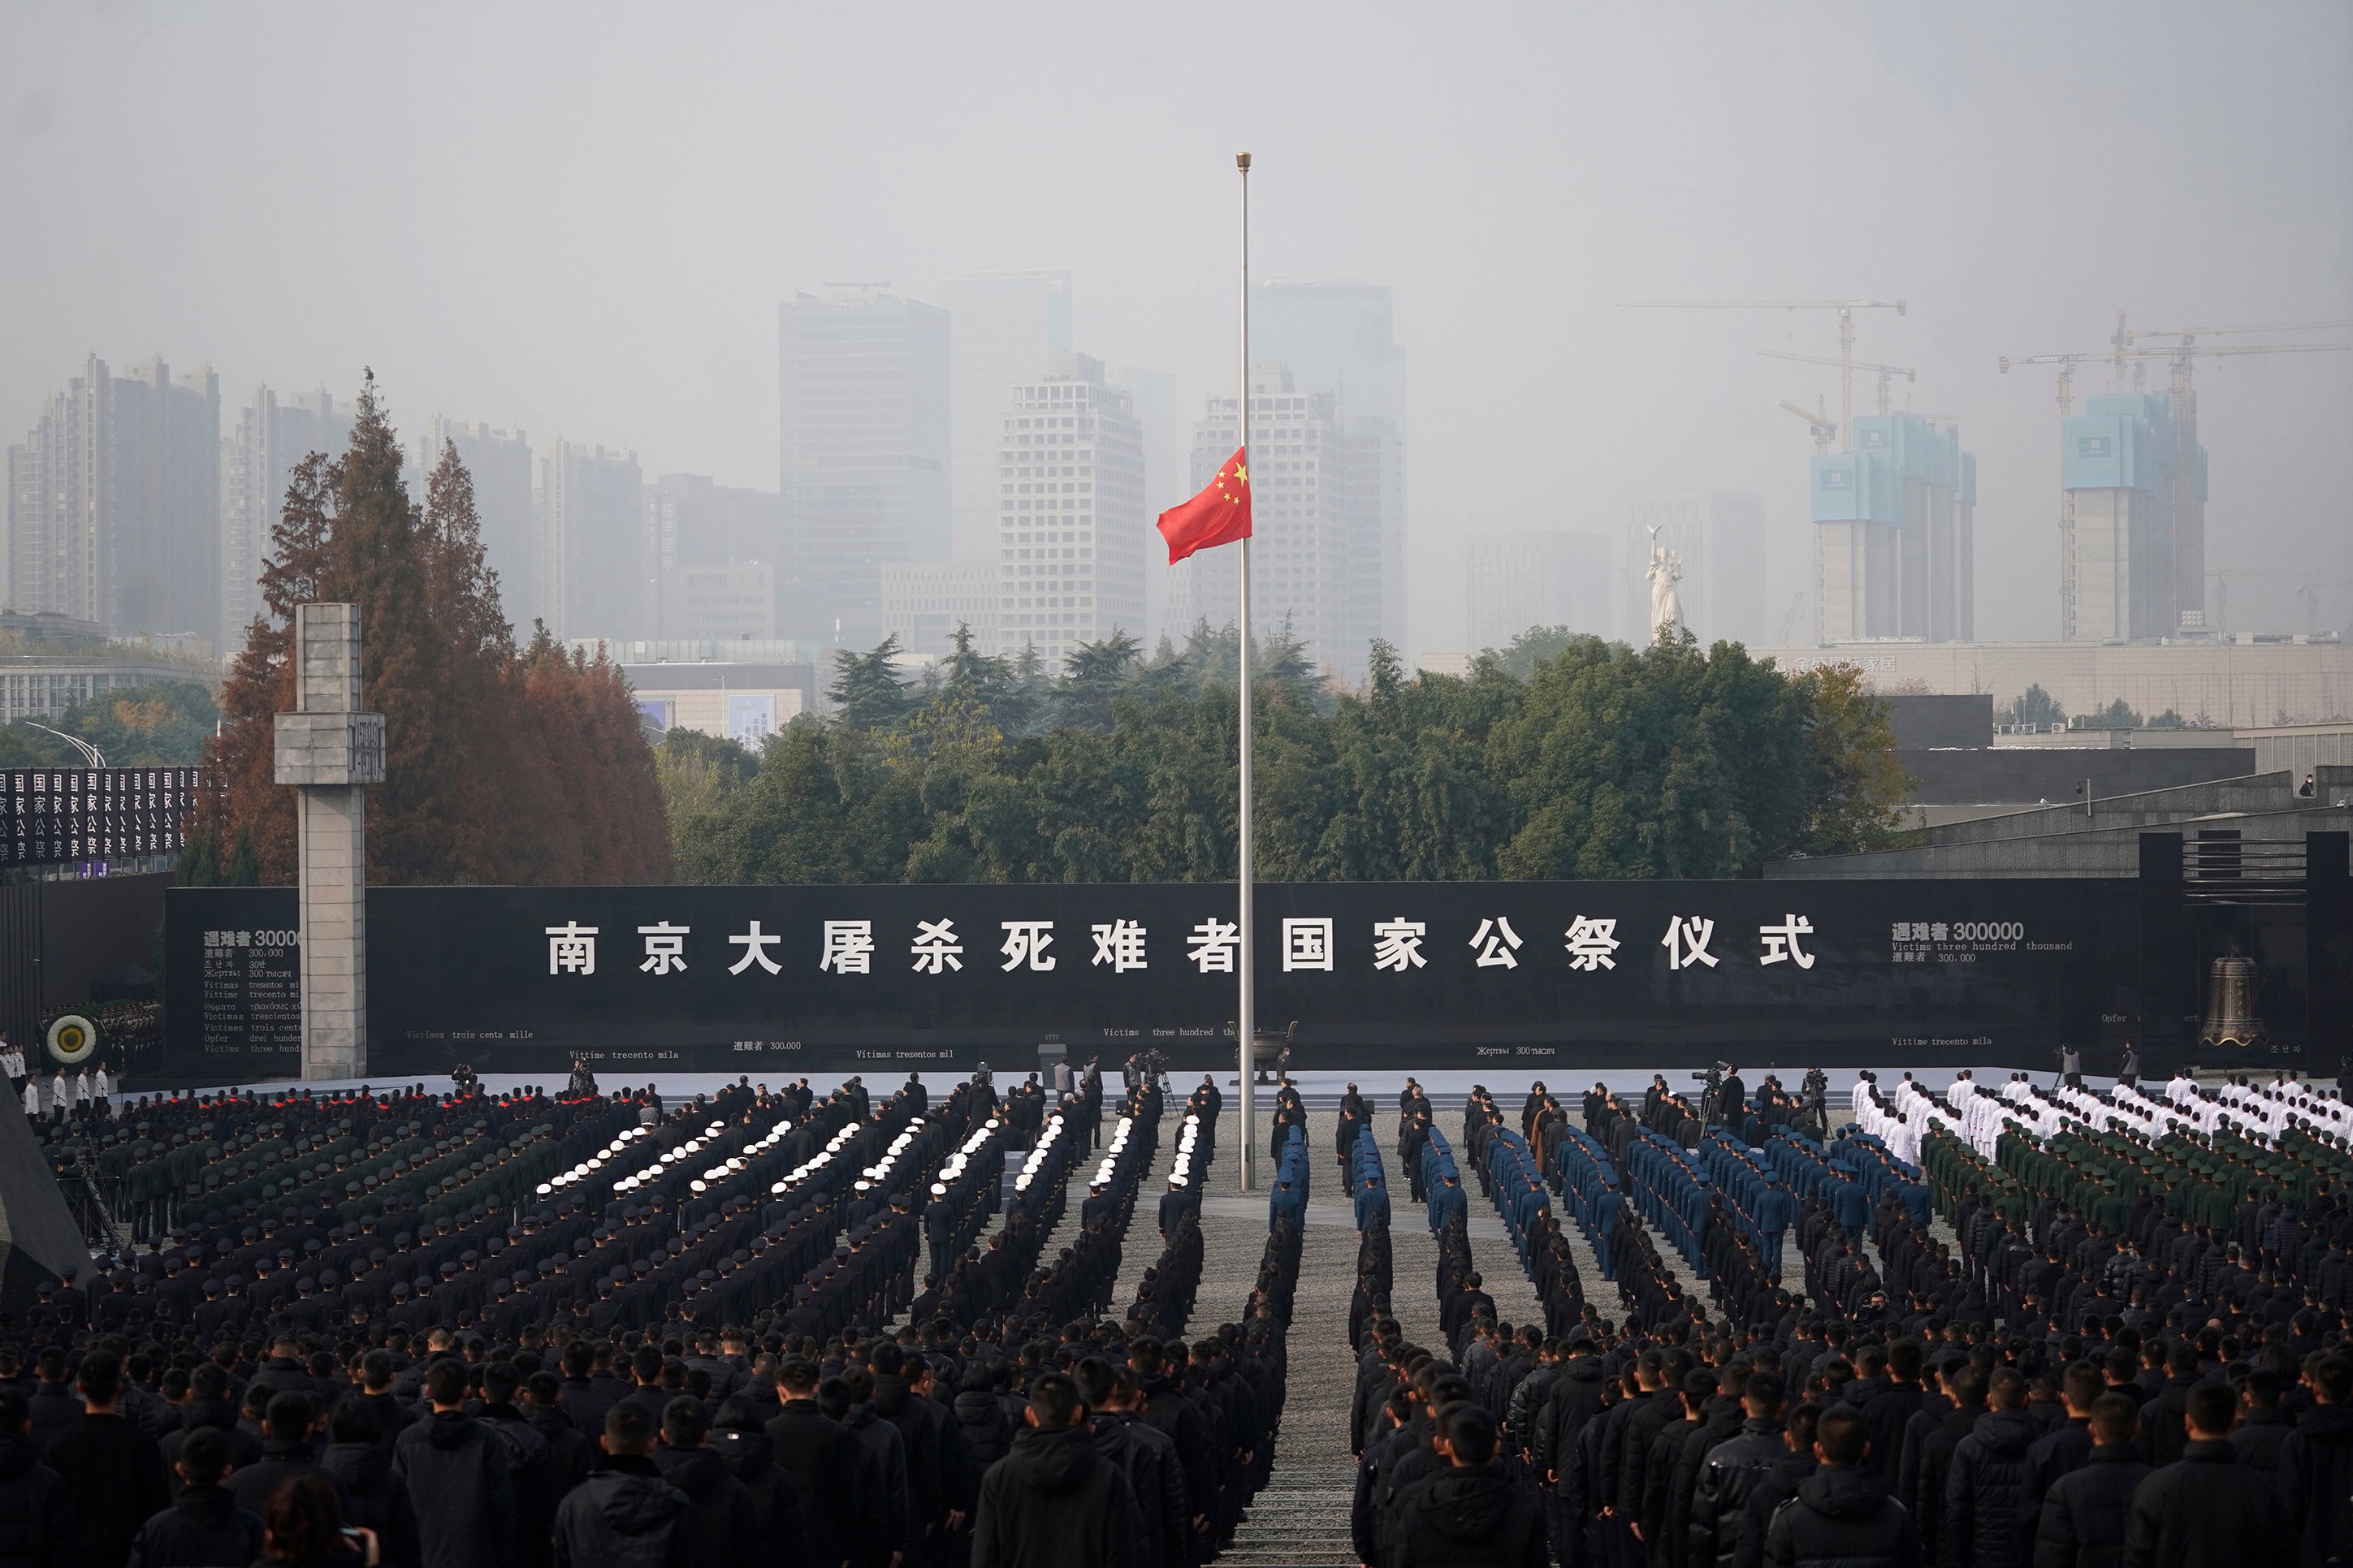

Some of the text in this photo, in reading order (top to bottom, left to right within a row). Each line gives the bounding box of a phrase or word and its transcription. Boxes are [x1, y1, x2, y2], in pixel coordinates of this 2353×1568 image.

[33, 774, 46, 857] 国家公祭
[87, 773, 97, 854] 国家公祭
[1953, 922, 2024, 941] 300000
[255, 930, 301, 947] 3000
[1892, 940, 2073, 952] Victims three hundred thousand
[249, 991, 287, 999] trecento
[2101, 1013, 2127, 1024] Opfer
[251, 1023, 275, 1031] trois
[1104, 1028, 1140, 1037] Victims
[1152, 1027, 1175, 1036] three
[1179, 1027, 1213, 1036] hundred
[204, 1033, 230, 1043] Opfer
[249, 1034, 267, 1042] drei
[452, 1030, 475, 1039] trois
[509, 1030, 534, 1039] mille
[1892, 1037, 1928, 1046] Vittime
[1972, 1036, 1992, 1045] mila
[251, 1044, 274, 1053] three
[569, 1050, 679, 1060] Vittime trecento mila
[896, 1051, 936, 1059] trezentos
[939, 1049, 954, 1058] mil
